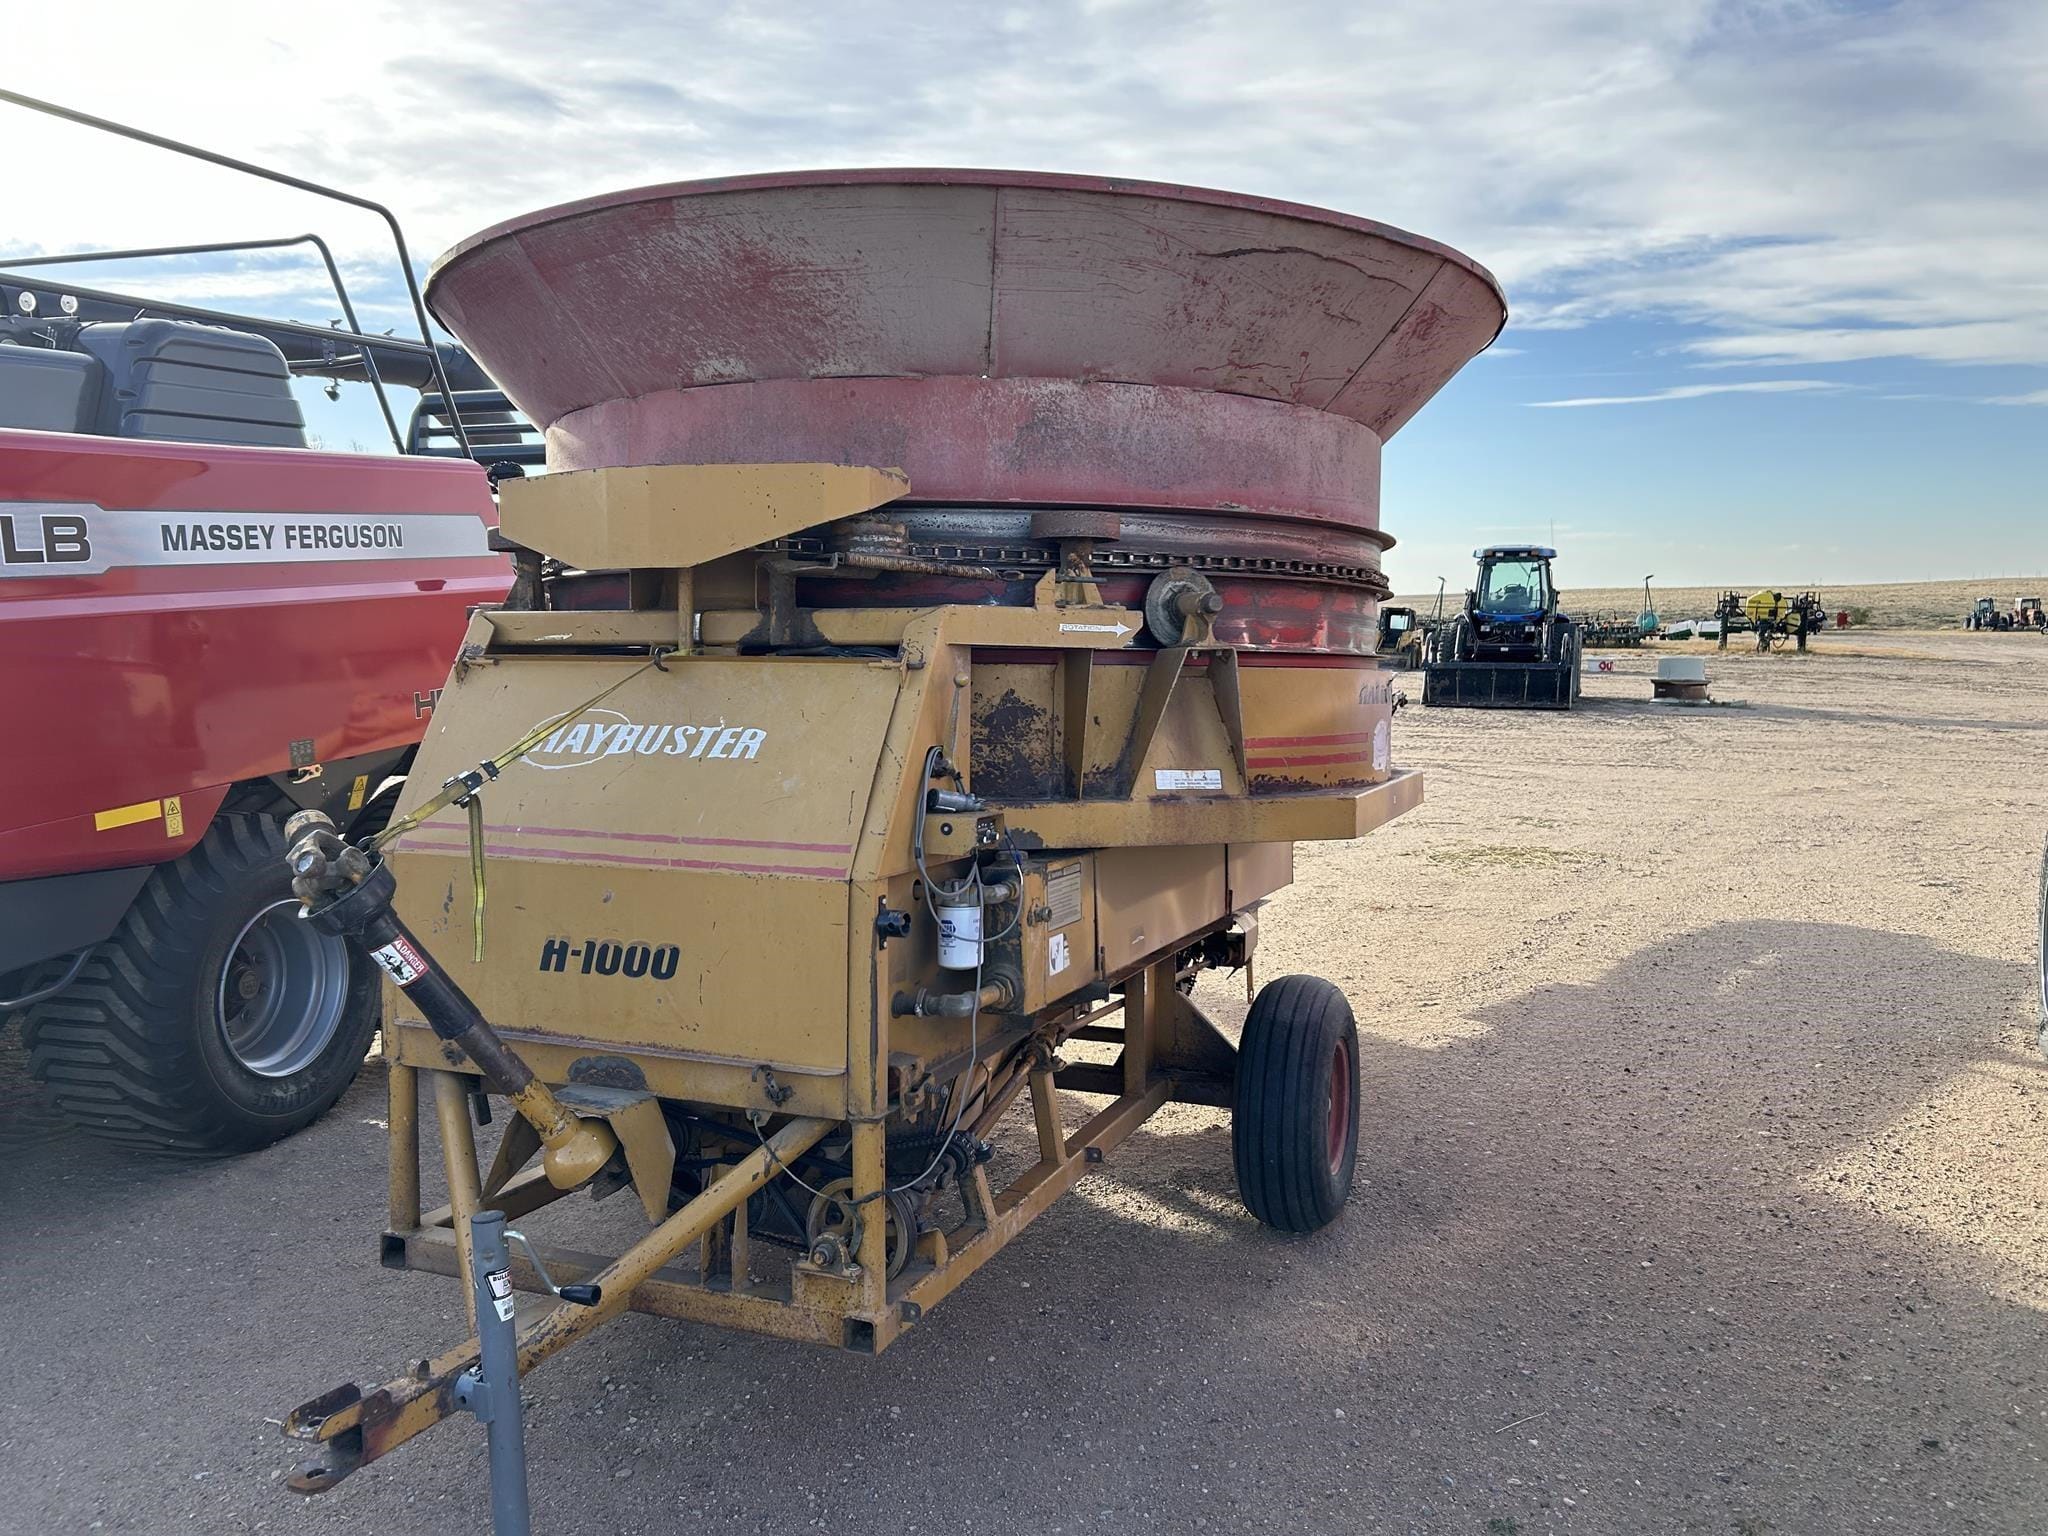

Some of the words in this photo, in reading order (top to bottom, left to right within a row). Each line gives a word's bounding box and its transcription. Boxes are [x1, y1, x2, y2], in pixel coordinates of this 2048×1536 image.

[0, 514, 92, 565] LB
[160, 523, 275, 551] MASSEY
[284, 524, 403, 549] FERGUSON
[400, 944, 425, 973] DANGER
[539, 937, 681, 980] H-1000
